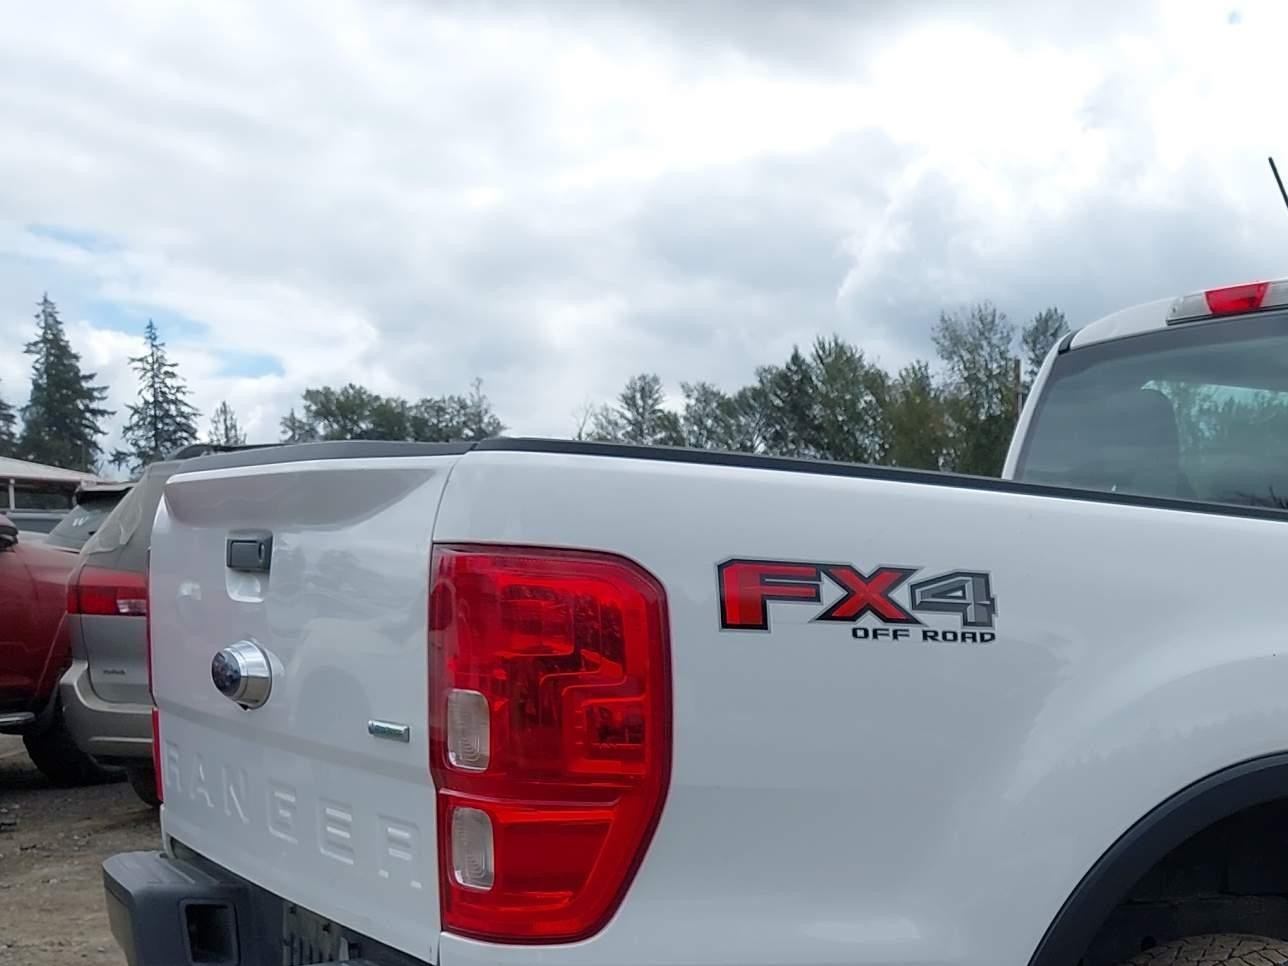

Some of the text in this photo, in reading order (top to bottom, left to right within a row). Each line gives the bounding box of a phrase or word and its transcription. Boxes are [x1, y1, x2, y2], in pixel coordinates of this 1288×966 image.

[716, 557, 997, 630] FX4
[852, 627, 996, 643] OFF ROAD
[164, 741, 422, 889] RANGER
